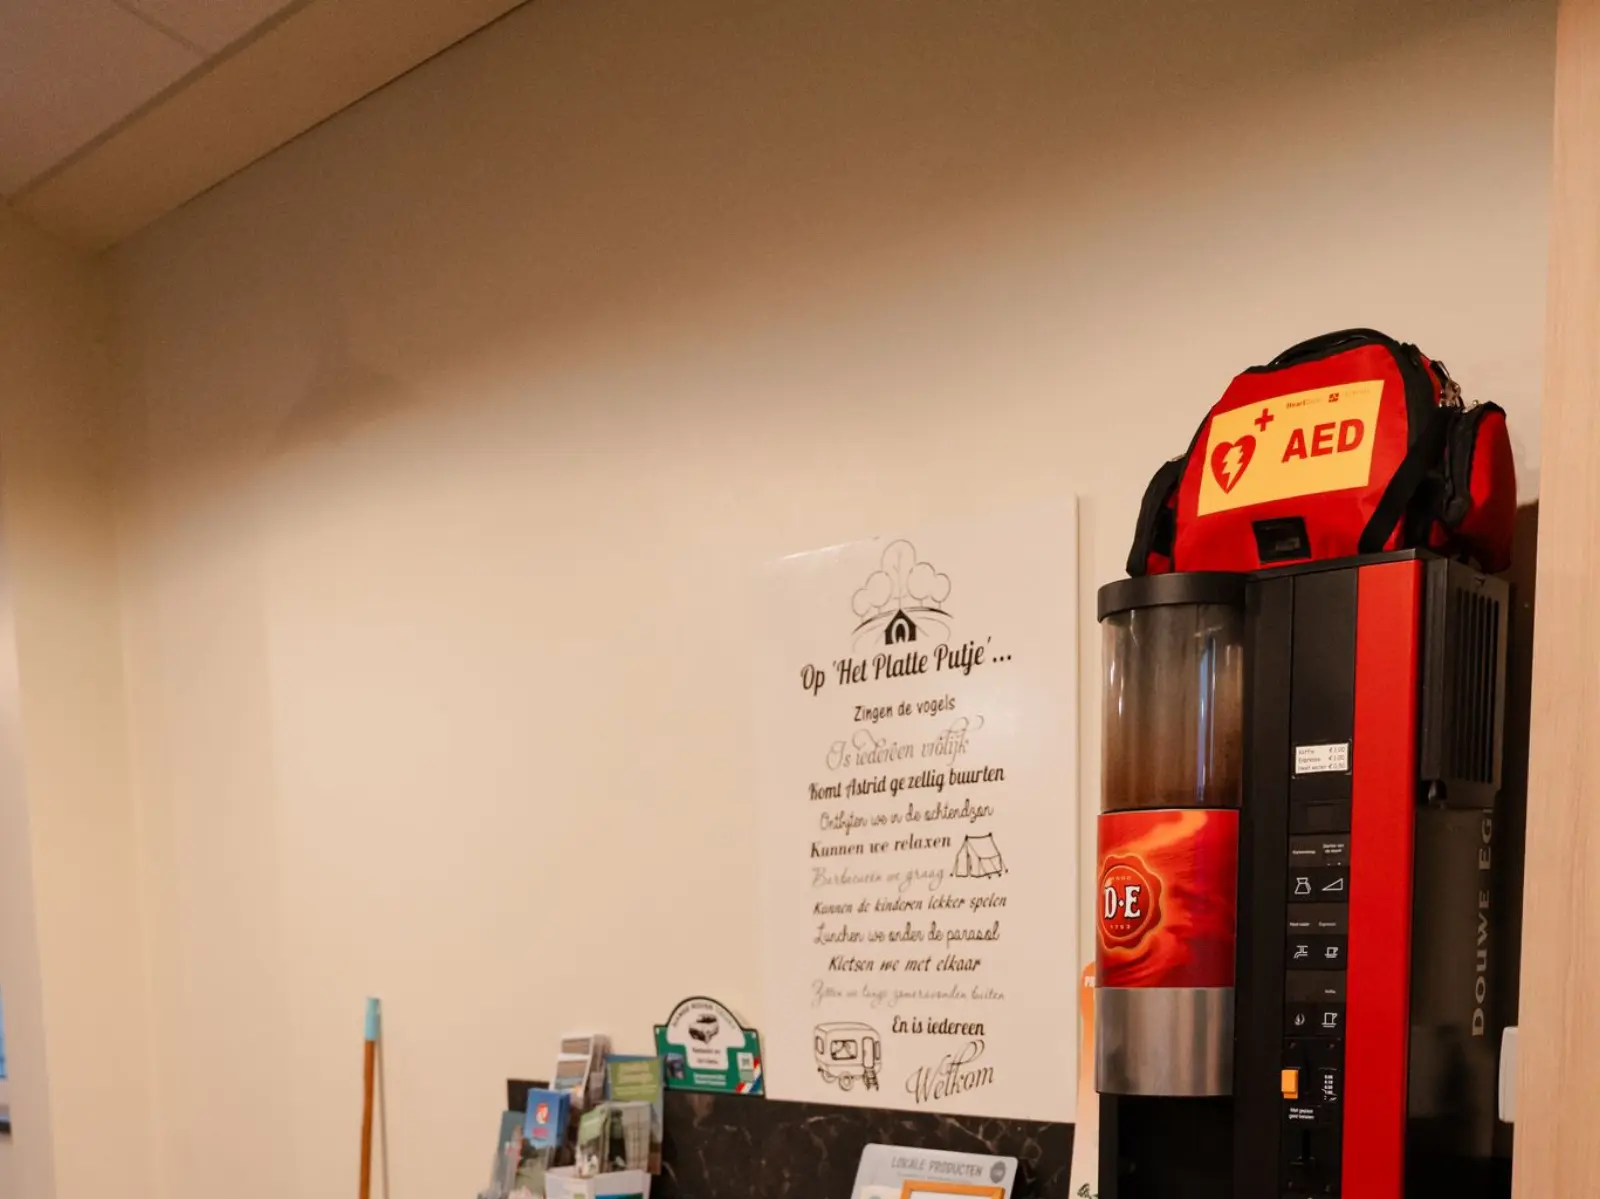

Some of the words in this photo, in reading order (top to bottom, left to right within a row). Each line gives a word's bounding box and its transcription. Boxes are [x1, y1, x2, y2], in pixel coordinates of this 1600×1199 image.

[1281, 418, 1365, 464] AED
[800, 664, 826, 696] Op
[872, 650, 928, 681] Platte
[854, 704, 893, 724] Zingen
[898, 701, 912, 717] de
[916, 694, 956, 717] vogels
[808, 782, 842, 801] Komt
[845, 775, 886, 799] Astrid
[949, 765, 1005, 786] buurten
[871, 816, 887, 827] we
[890, 814, 902, 824] in
[905, 803, 920, 823] de
[810, 841, 864, 858] Kunnen
[870, 841, 889, 854] we
[894, 833, 952, 851] relaxen
[1478, 808, 1493, 870] EG
[898, 867, 945, 893] graag
[813, 901, 853, 915] Kunnen
[857, 897, 870, 913] de
[874, 896, 923, 912] kinderen
[928, 894, 965, 910] lekker
[969, 892, 1007, 914] spelen
[813, 922, 864, 946] Lunchen
[868, 930, 886, 943] we
[888, 920, 925, 943] onder
[927, 920, 944, 942] de
[946, 920, 1000, 949] parasol
[828, 955, 874, 972] Kletsen
[880, 959, 900, 972] we
[904, 955, 932, 972] met
[936, 953, 981, 972] elkaar
[1472, 890, 1490, 1036] DOUWE
[971, 985, 1005, 1001] buiten
[892, 1015, 909, 1034] En
[912, 1016, 924, 1034] is
[927, 1016, 985, 1037] iedereen
[905, 1039, 994, 1104] Welkom
[891, 1156, 925, 1171] LOKALE
[929, 1158, 984, 1178] PRODUCTEN
